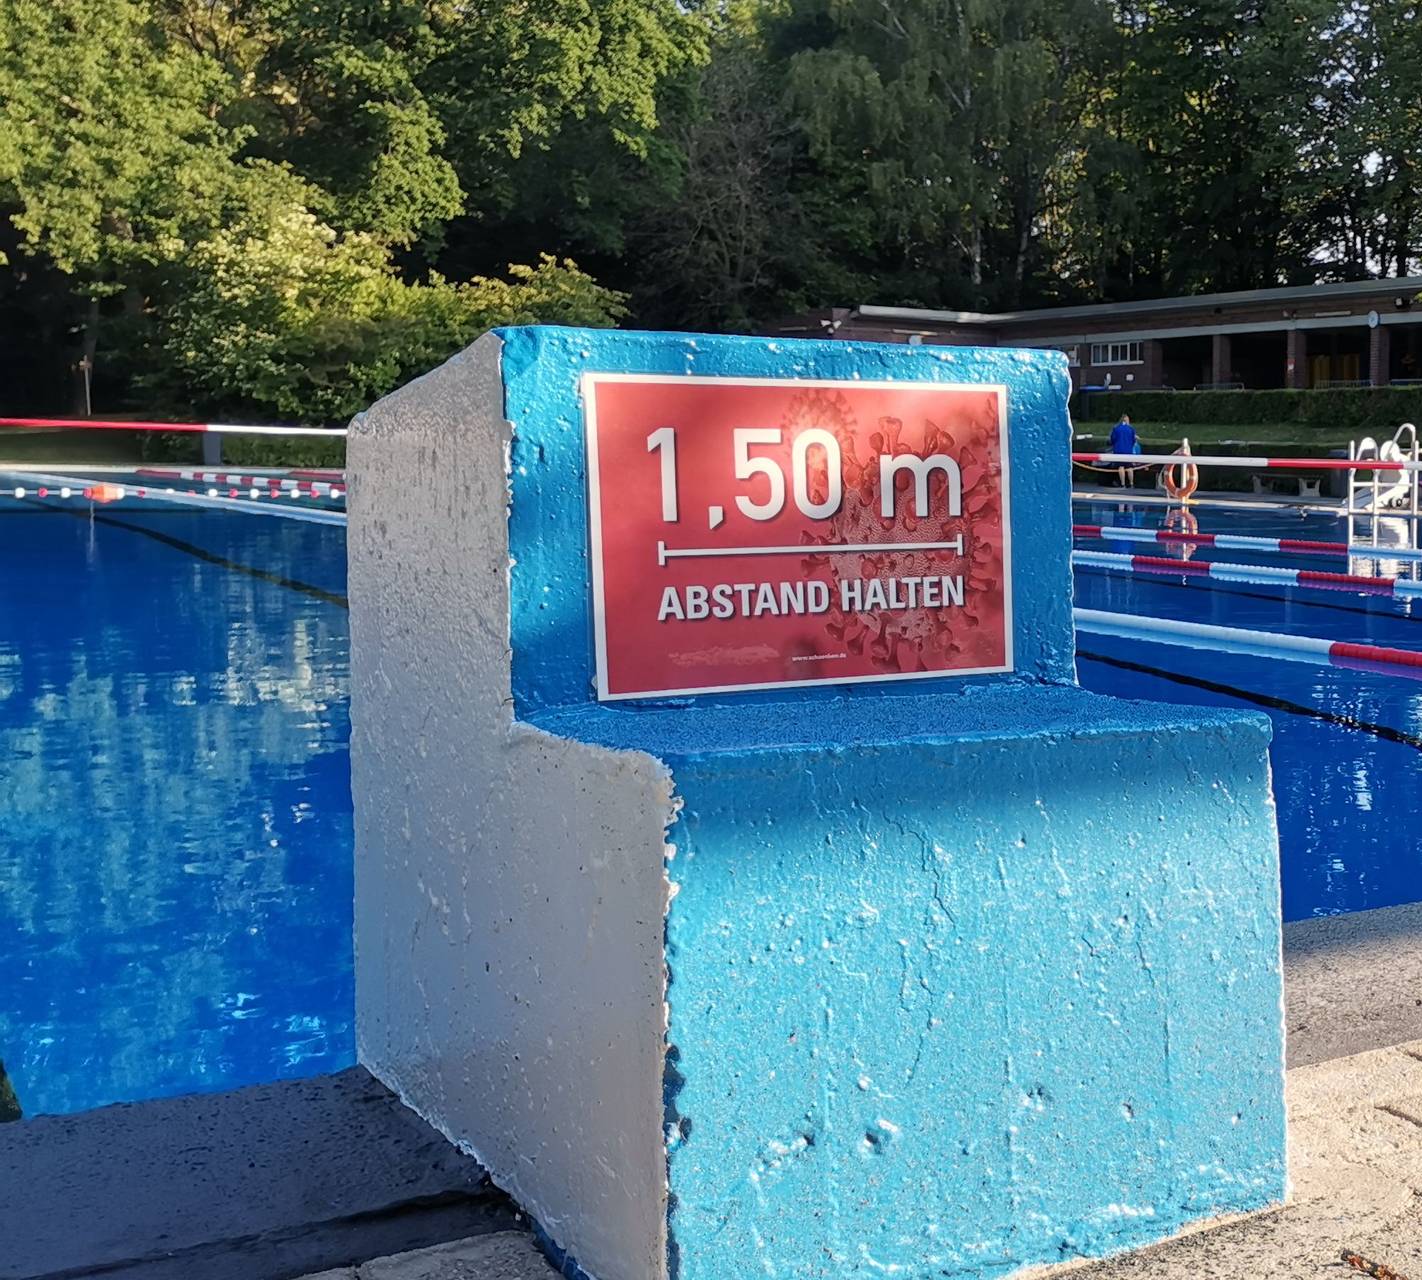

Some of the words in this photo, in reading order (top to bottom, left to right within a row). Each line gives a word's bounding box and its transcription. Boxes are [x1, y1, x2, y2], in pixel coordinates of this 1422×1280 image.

[646, 427, 842, 530] 1,50
[880, 452, 962, 518] m
[657, 579, 830, 621] ABSTAND
[840, 575, 965, 613] HALTEN
